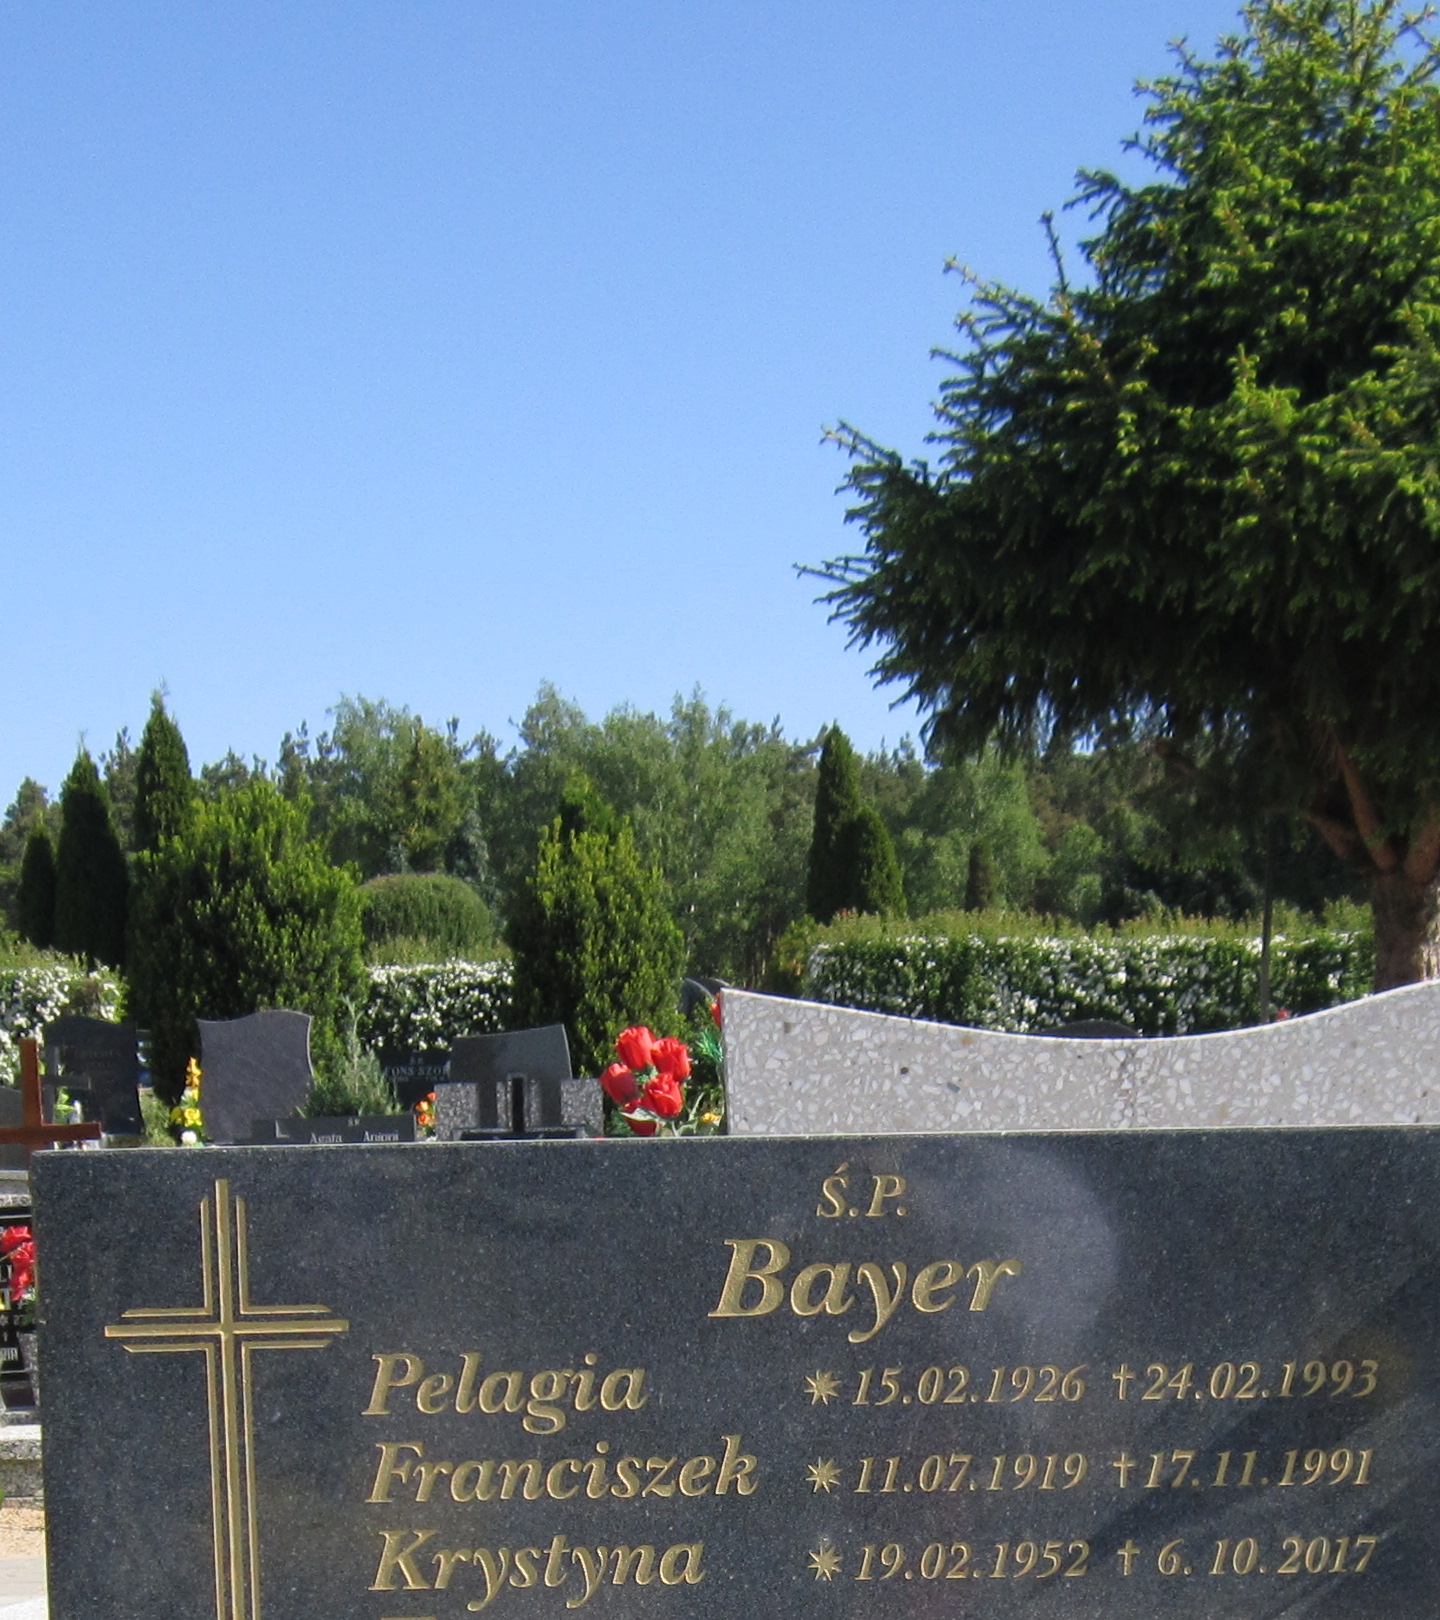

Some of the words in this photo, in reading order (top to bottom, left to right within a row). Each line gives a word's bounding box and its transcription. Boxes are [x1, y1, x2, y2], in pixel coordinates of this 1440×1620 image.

[708, 1238, 1020, 1343] Bayer
[363, 1352, 646, 1435] Pelagia
[852, 1364, 1086, 1406] 15.02.1926
[1142, 1360, 1379, 1400] 24.02.1993
[366, 1436, 758, 1504] Franciszek
[854, 1453, 1089, 1493] 11.07.1919
[1145, 1448, 1373, 1488] 17.11.1991
[368, 1528, 706, 1611] Krystyna
[854, 1540, 1090, 1581] 19.02.1952
